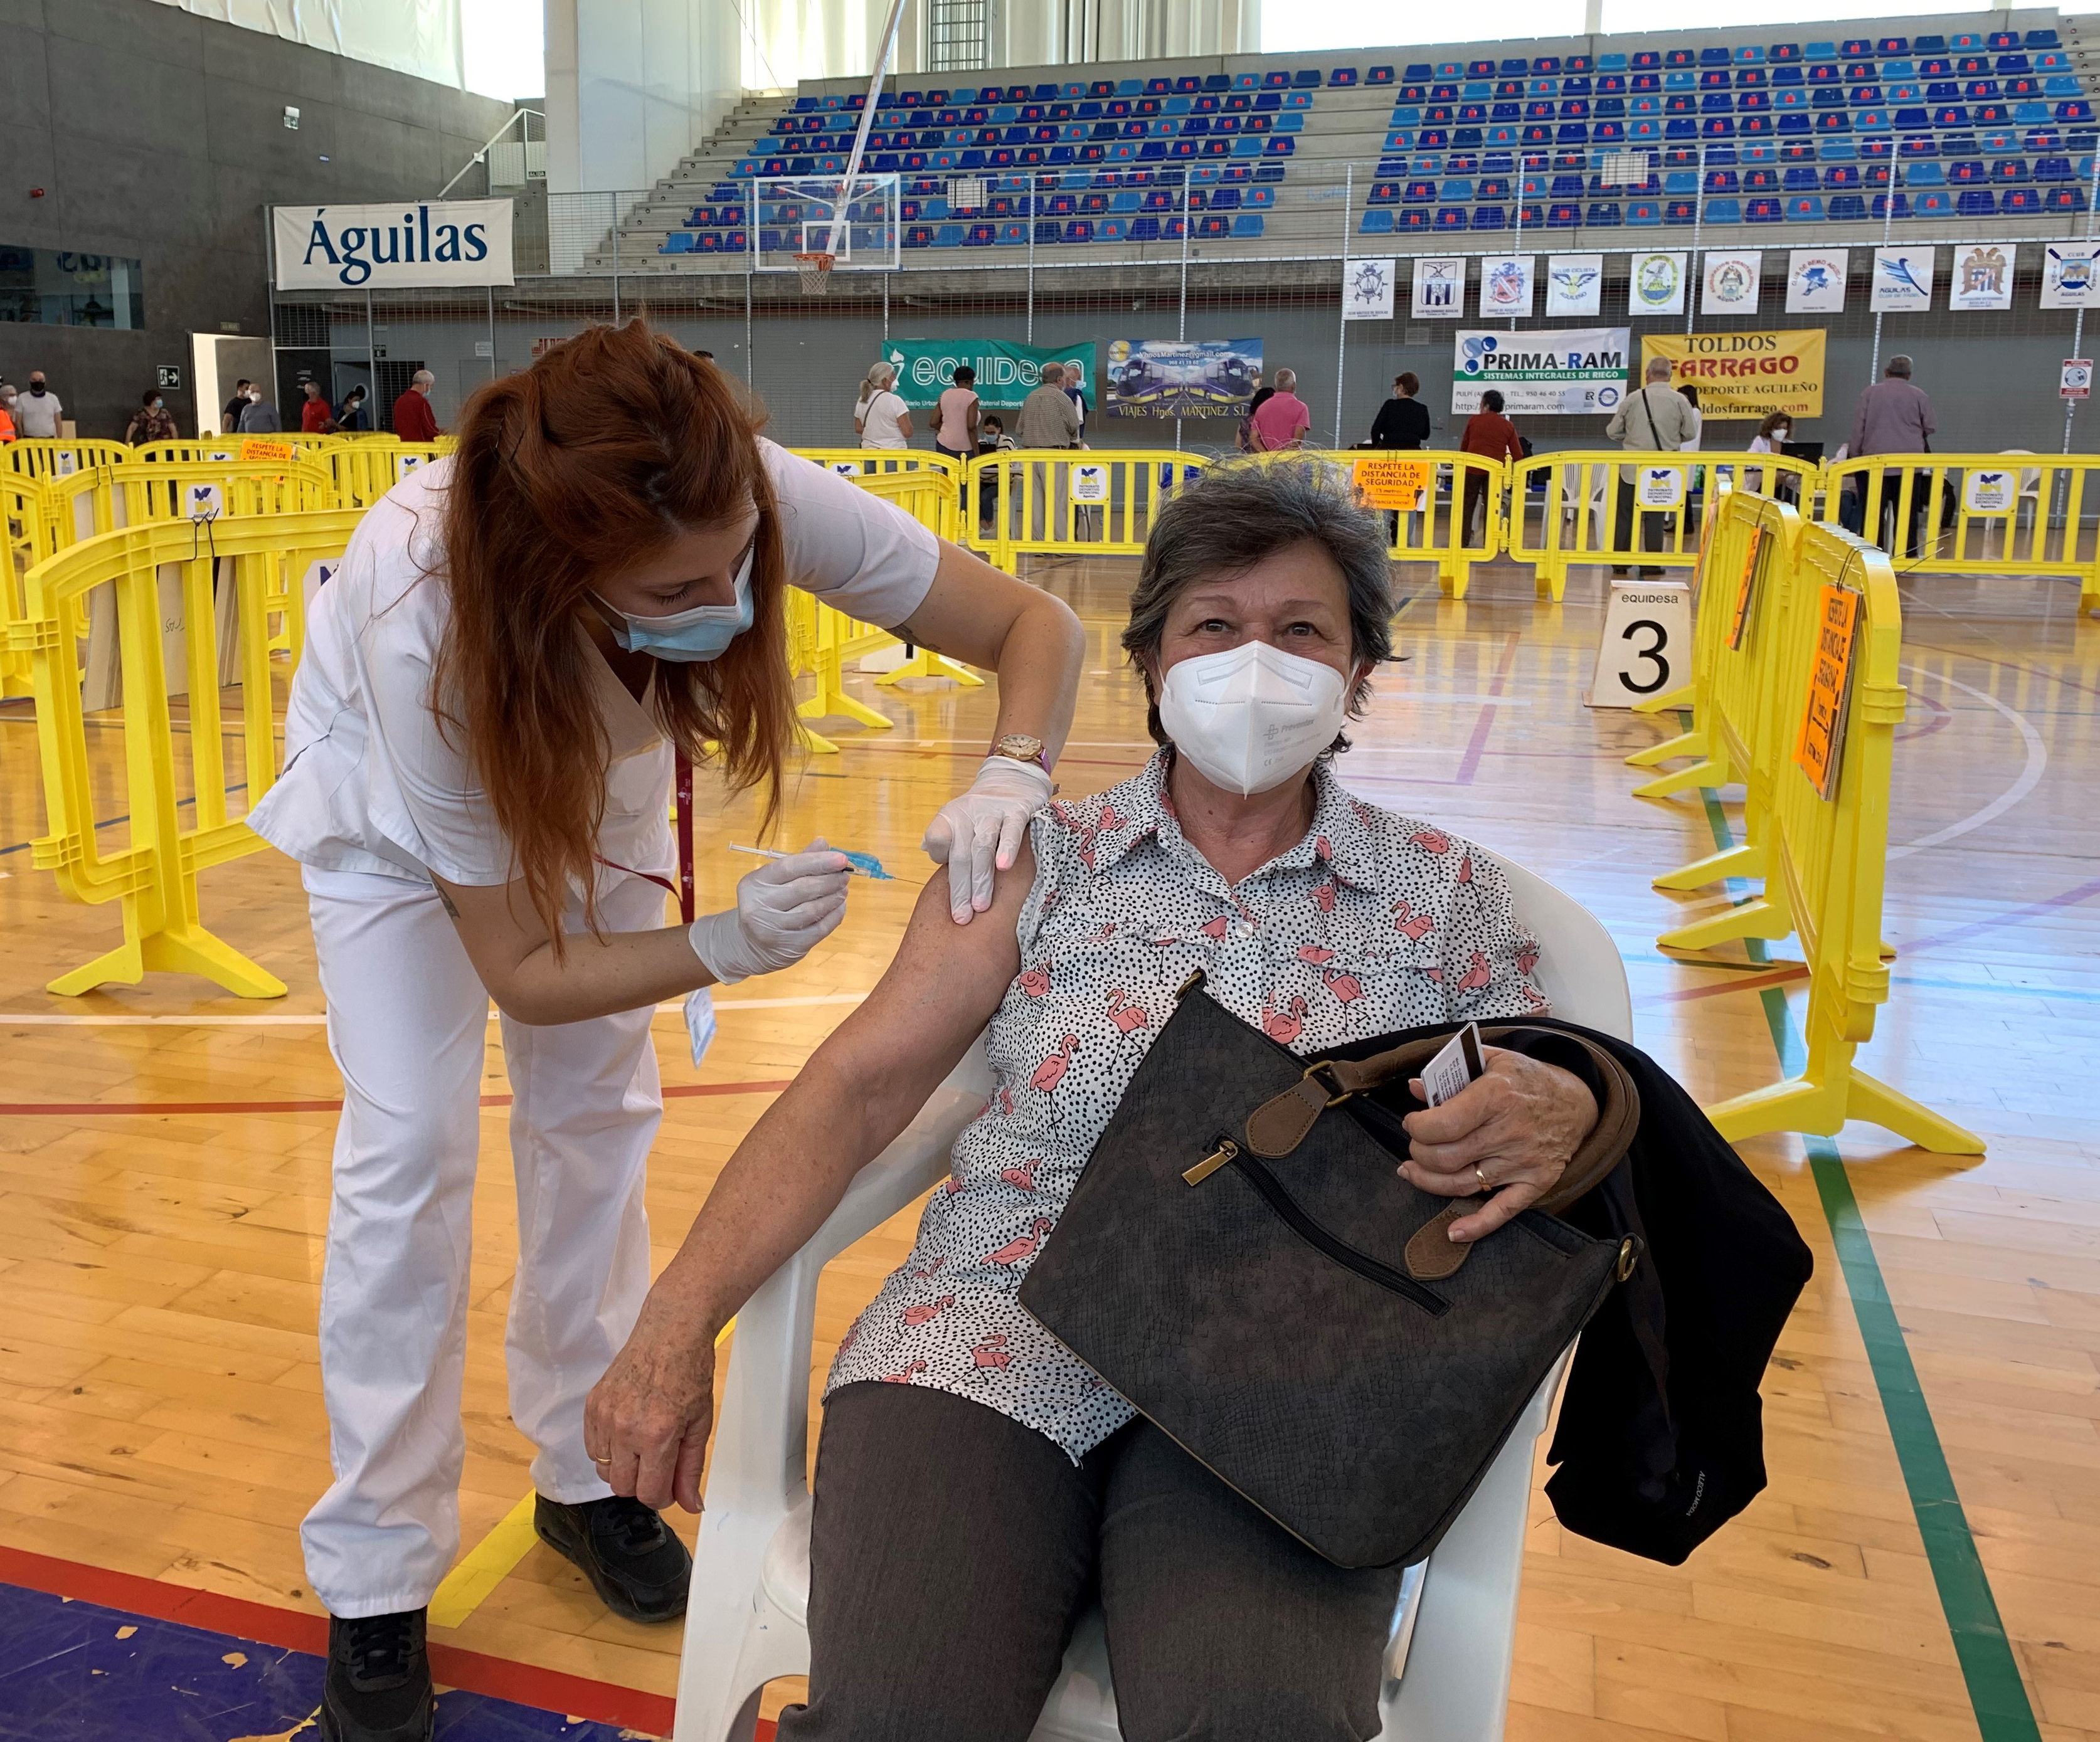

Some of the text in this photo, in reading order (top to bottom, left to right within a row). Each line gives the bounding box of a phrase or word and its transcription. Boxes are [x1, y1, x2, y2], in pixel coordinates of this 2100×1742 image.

[303, 206, 487, 285] Águilas
[1685, 335, 1777, 353] TOLDOS
[1484, 352, 1621, 369] PRIMA-RAM
[1669, 355, 1799, 378] FARRAGO
[1483, 372, 1524, 380] SISTEMAS
[1697, 381, 1818, 395] DEPORTE AGUILEÑO
[1119, 405, 1147, 417] VIAJES
[1181, 406, 1229, 416] MARTINEZ
[247, 448, 277, 458] DISTANCIA
[1361, 470, 1406, 478] DISTANCIA
[1366, 478, 1414, 487] SEGURIDAD
[1619, 620, 1670, 694] 3
